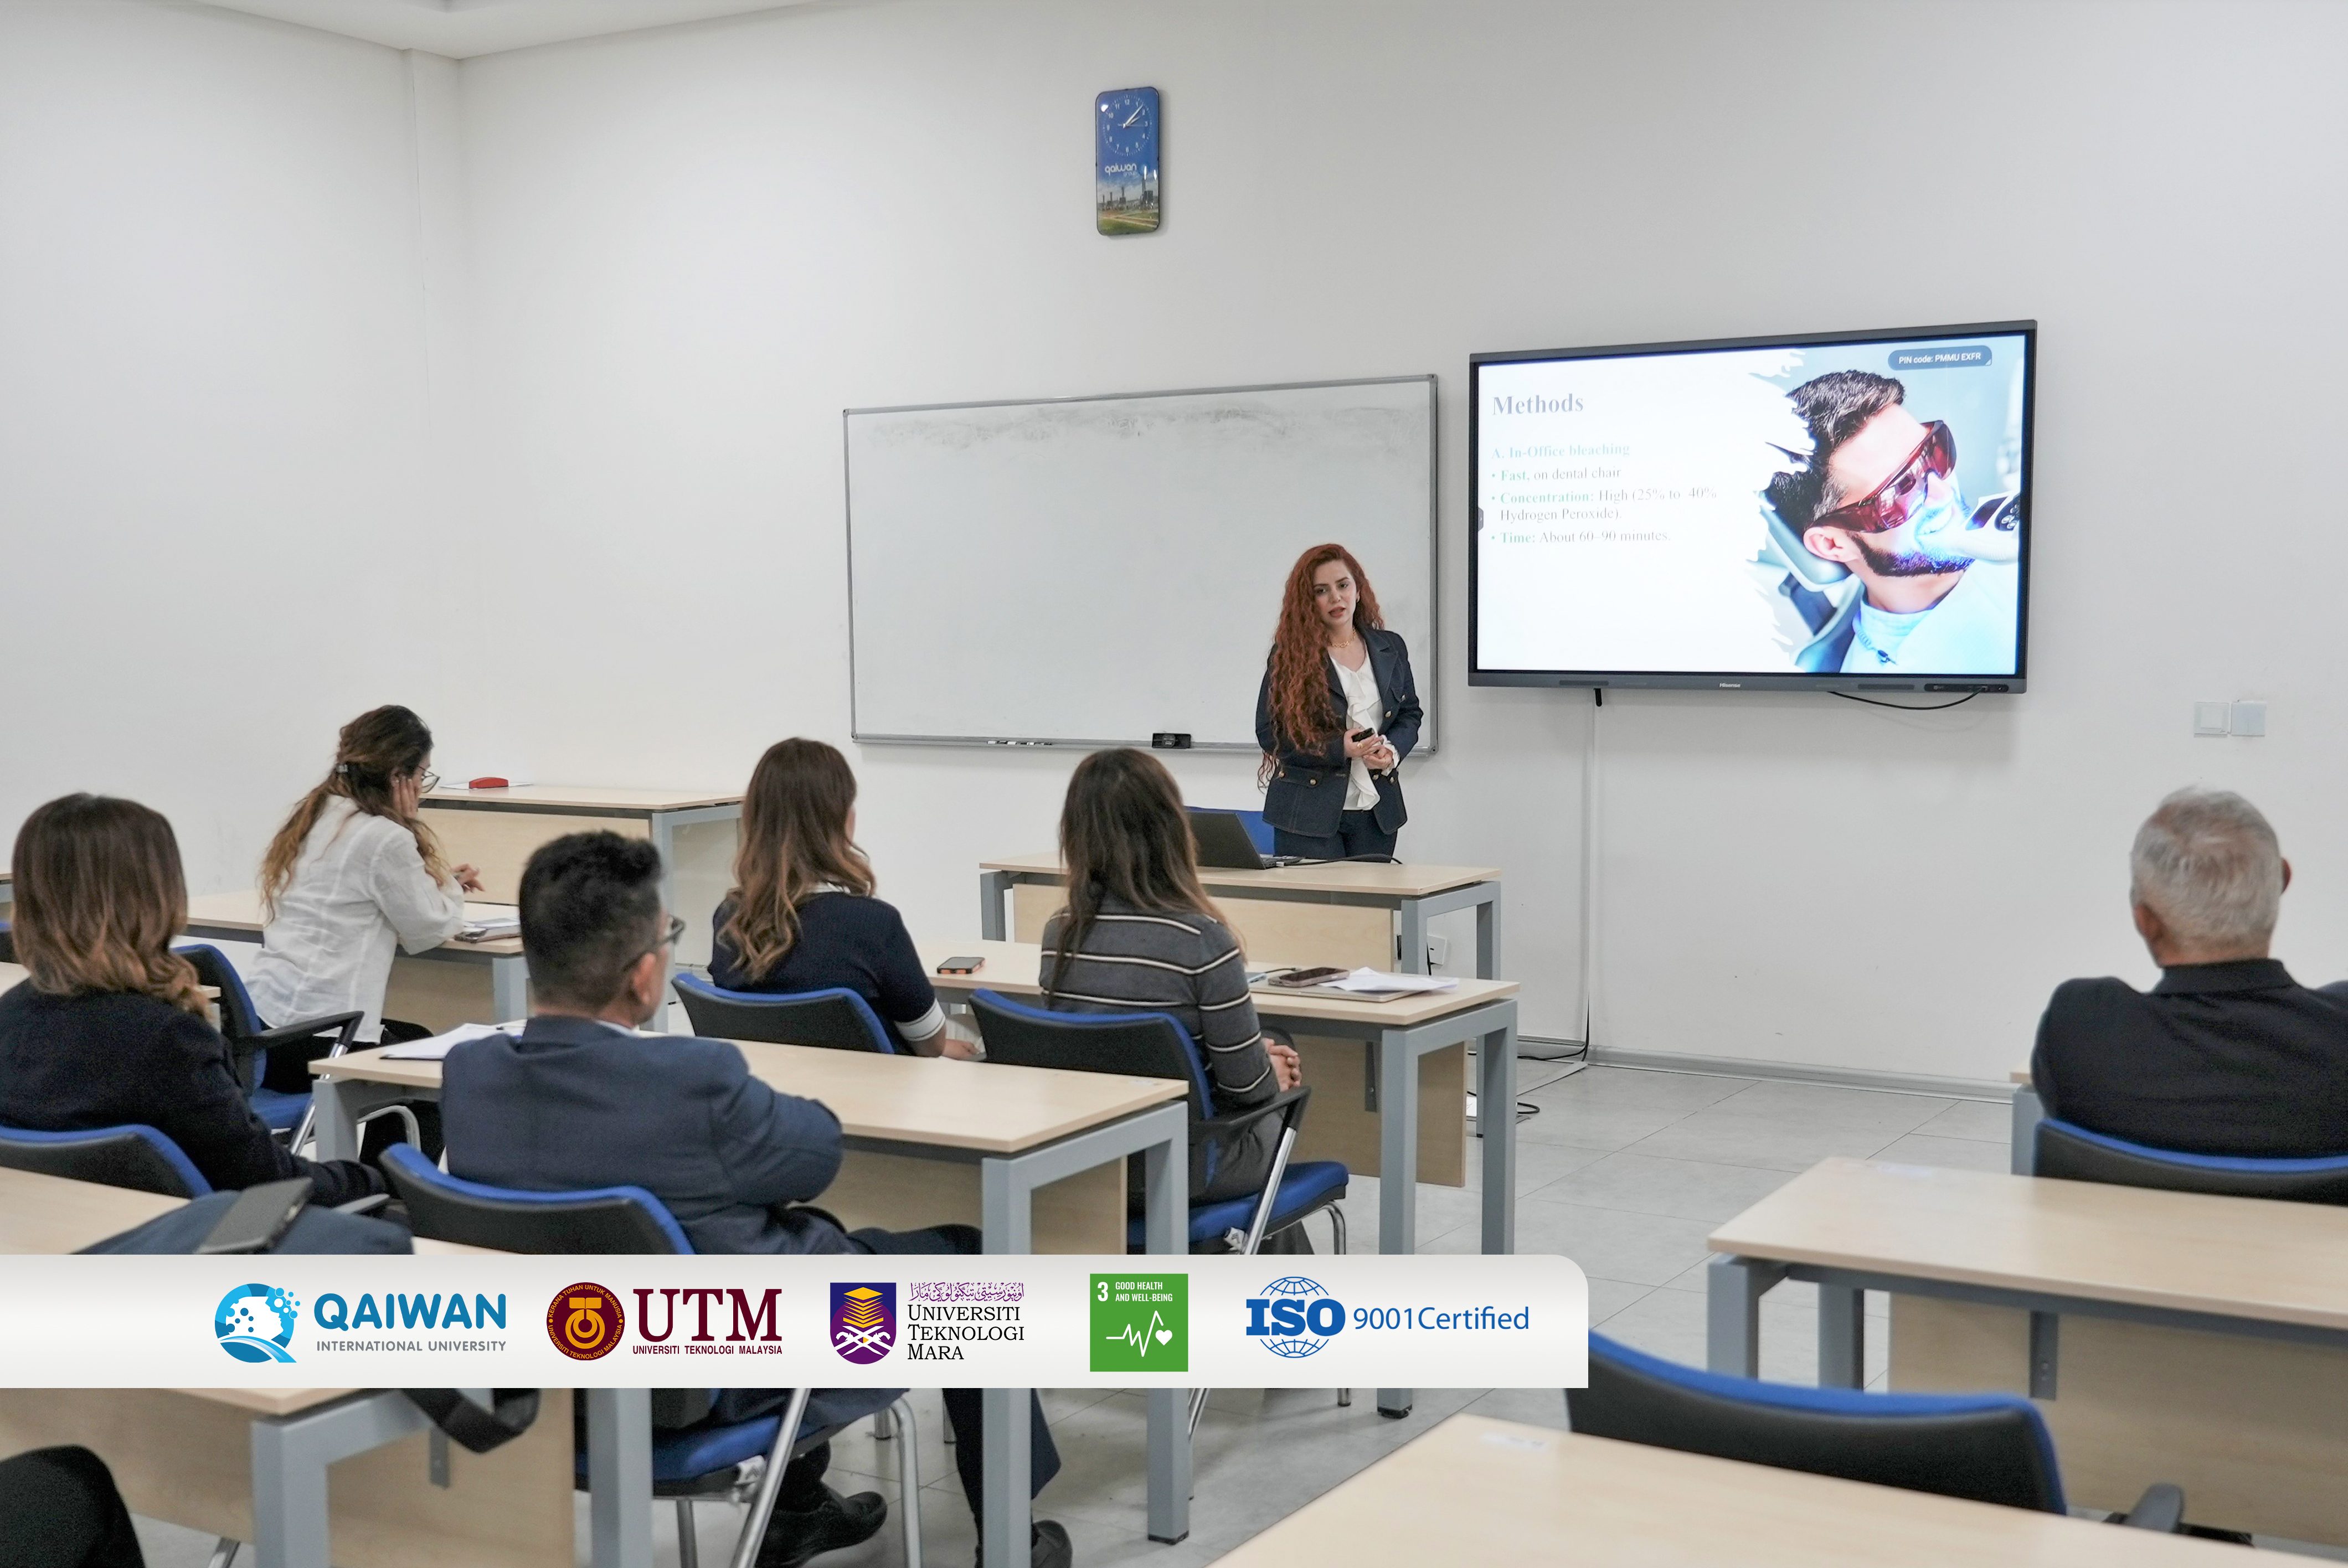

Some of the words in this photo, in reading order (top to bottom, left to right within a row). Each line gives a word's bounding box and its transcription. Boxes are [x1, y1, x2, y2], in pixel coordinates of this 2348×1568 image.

[1105, 163, 1137, 176] qaiwan
[1913, 354, 1933, 363] code:
[1935, 353, 1959, 362] PMMU
[1961, 352, 1981, 360] EXFR
[1492, 393, 1584, 415] Methods
[1492, 448, 1505, 458] A.
[1510, 445, 1565, 458] In-Office
[1569, 443, 1630, 457] bleaching
[1501, 469, 1530, 482] Fast,
[1534, 471, 1548, 480] on
[1552, 467, 1587, 479] dental
[1592, 466, 1621, 478] chair
[1501, 491, 1594, 504] Concentration:
[1599, 489, 1628, 504] High
[1632, 488, 1665, 501] (25%
[1669, 489, 1681, 500] to
[1688, 486, 1717, 499] 40%
[1501, 509, 1557, 523] Hydrogen
[1562, 507, 1622, 520] Peroxide).
[1501, 532, 1536, 544] Time:
[1539, 530, 1575, 543] About
[1620, 530, 1671, 541] minutes.
